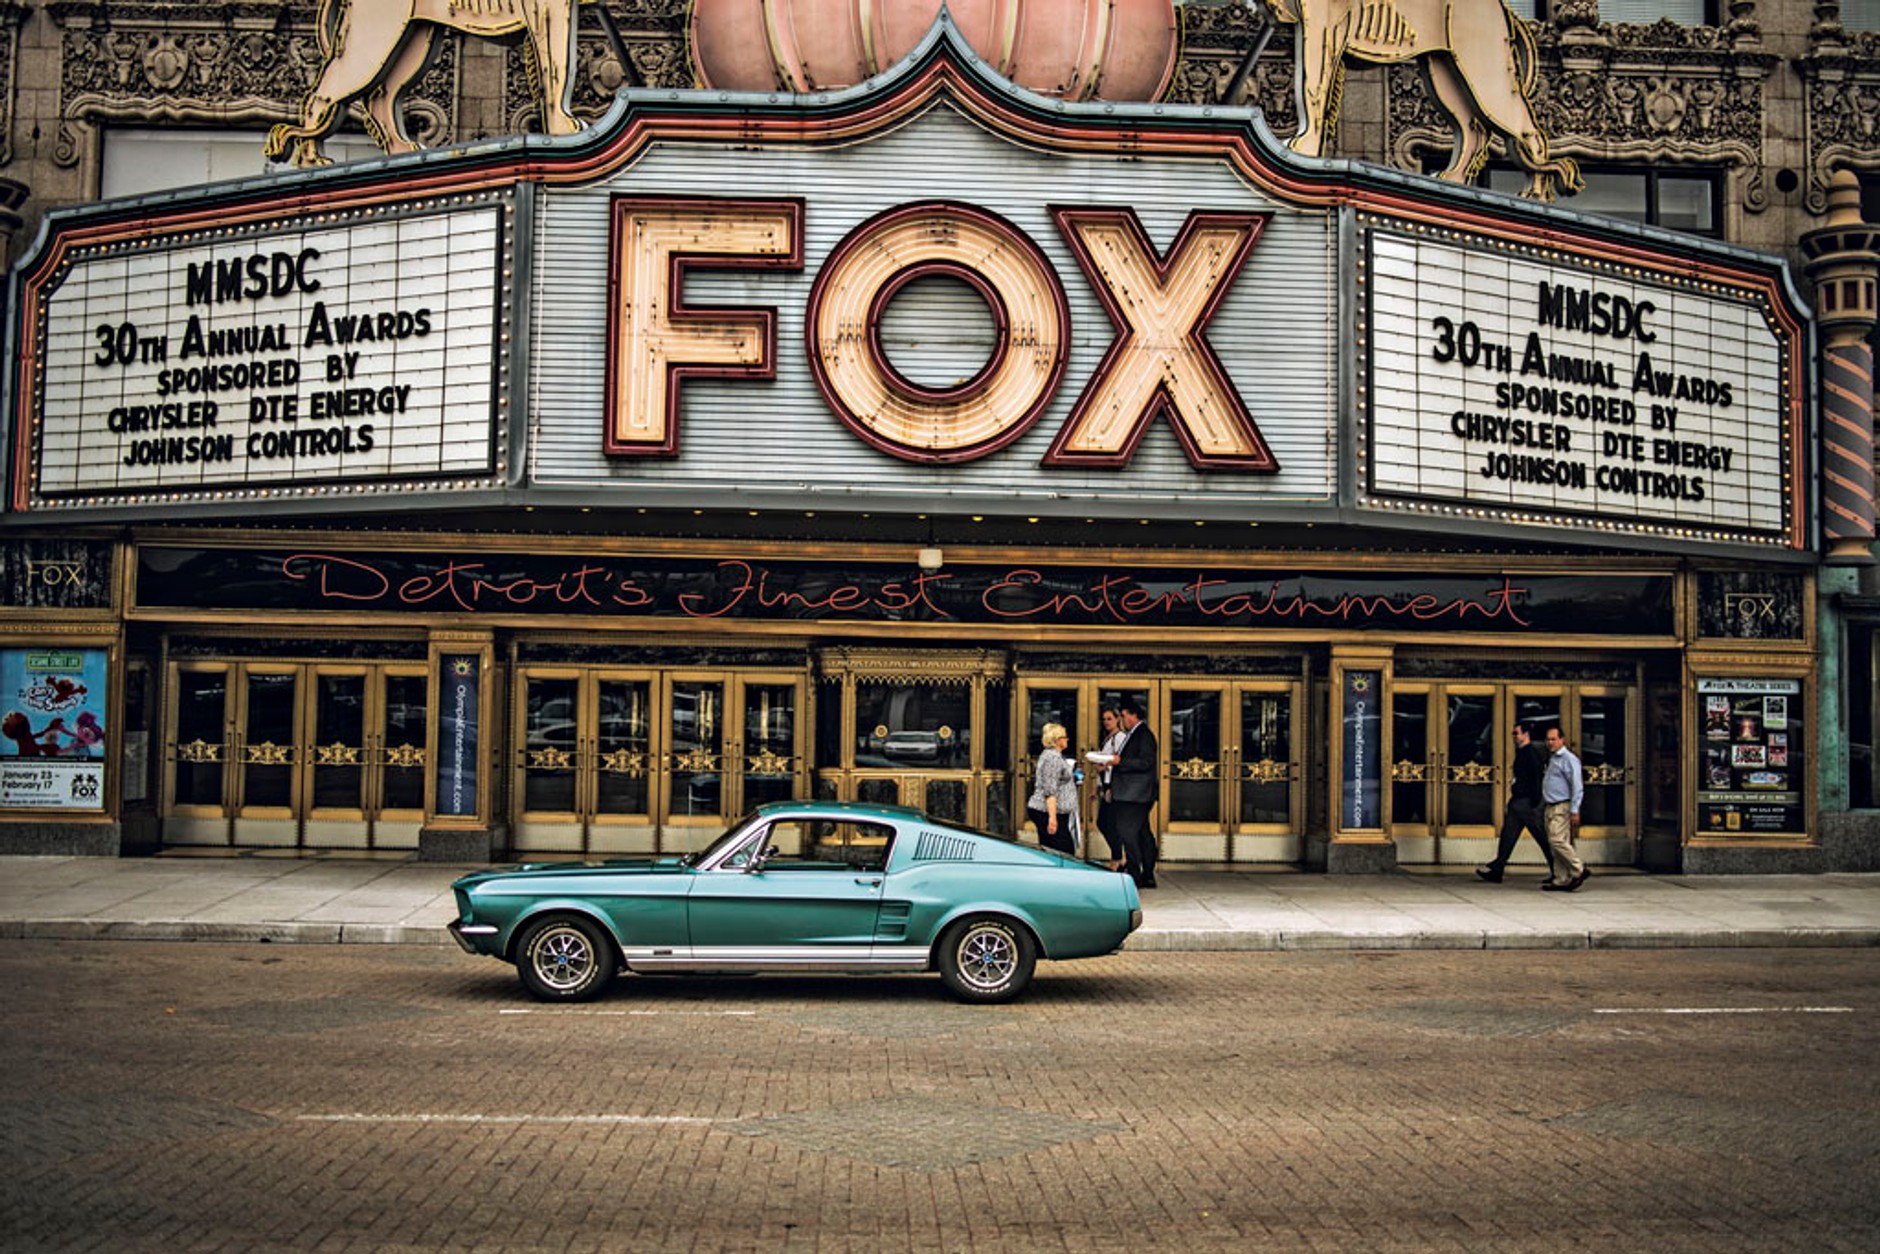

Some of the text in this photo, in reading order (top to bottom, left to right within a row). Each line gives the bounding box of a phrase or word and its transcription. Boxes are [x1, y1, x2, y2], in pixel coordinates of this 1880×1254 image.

[186, 247, 321, 306] MMSDC
[603, 192, 1281, 473] FOX
[1538, 281, 1657, 344] MMSDC
[156, 351, 360, 396] SPONSORED BY
[107, 384, 411, 434] CHRYSLER DTE ENERGY
[1495, 382, 1678, 432] SPONSORED BY
[123, 424, 374, 467] JOHNSON CONTROLS
[1450, 411, 1733, 472] CHRYSLER DTE ENERGY
[1480, 451, 1705, 502] JOHNSON CONTROLS
[27, 560, 82, 587] FOX
[282, 554, 1533, 626] Detroit's Finest Entertainment
[1724, 593, 1776, 620] FOX
[2, 781, 53, 791] February 17
[3, 770, 37, 781] January
[72, 786, 97, 797] FOX
